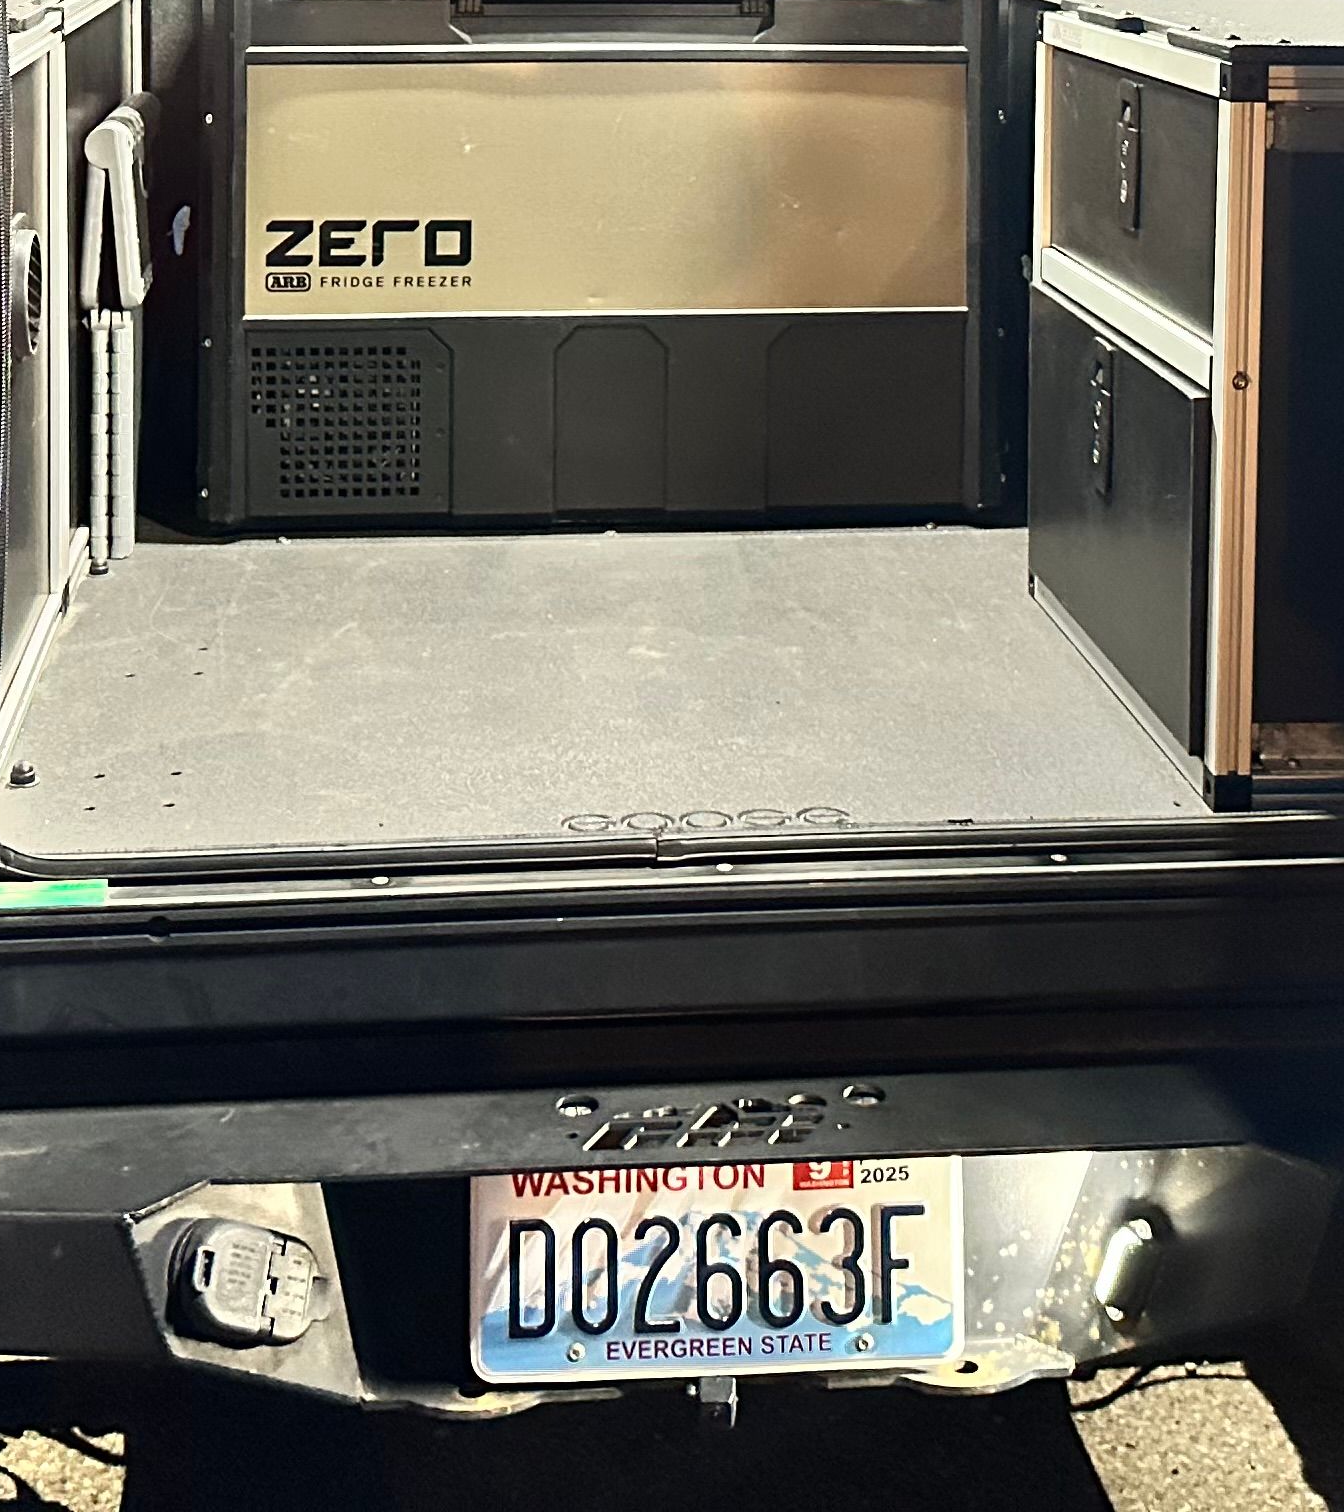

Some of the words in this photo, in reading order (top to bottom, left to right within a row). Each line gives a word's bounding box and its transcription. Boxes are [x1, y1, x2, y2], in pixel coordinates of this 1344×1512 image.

[270, 276, 308, 289] ARB
[320, 276, 385, 288] FRIDGE
[393, 275, 472, 288] FREEZER
[511, 1163, 766, 1197] WASHINGTON
[860, 1165, 910, 1184] 2025
[508, 1204, 926, 1339] D02663F
[606, 1335, 753, 1362] EVERGREEN
[761, 1332, 833, 1355] STATE
